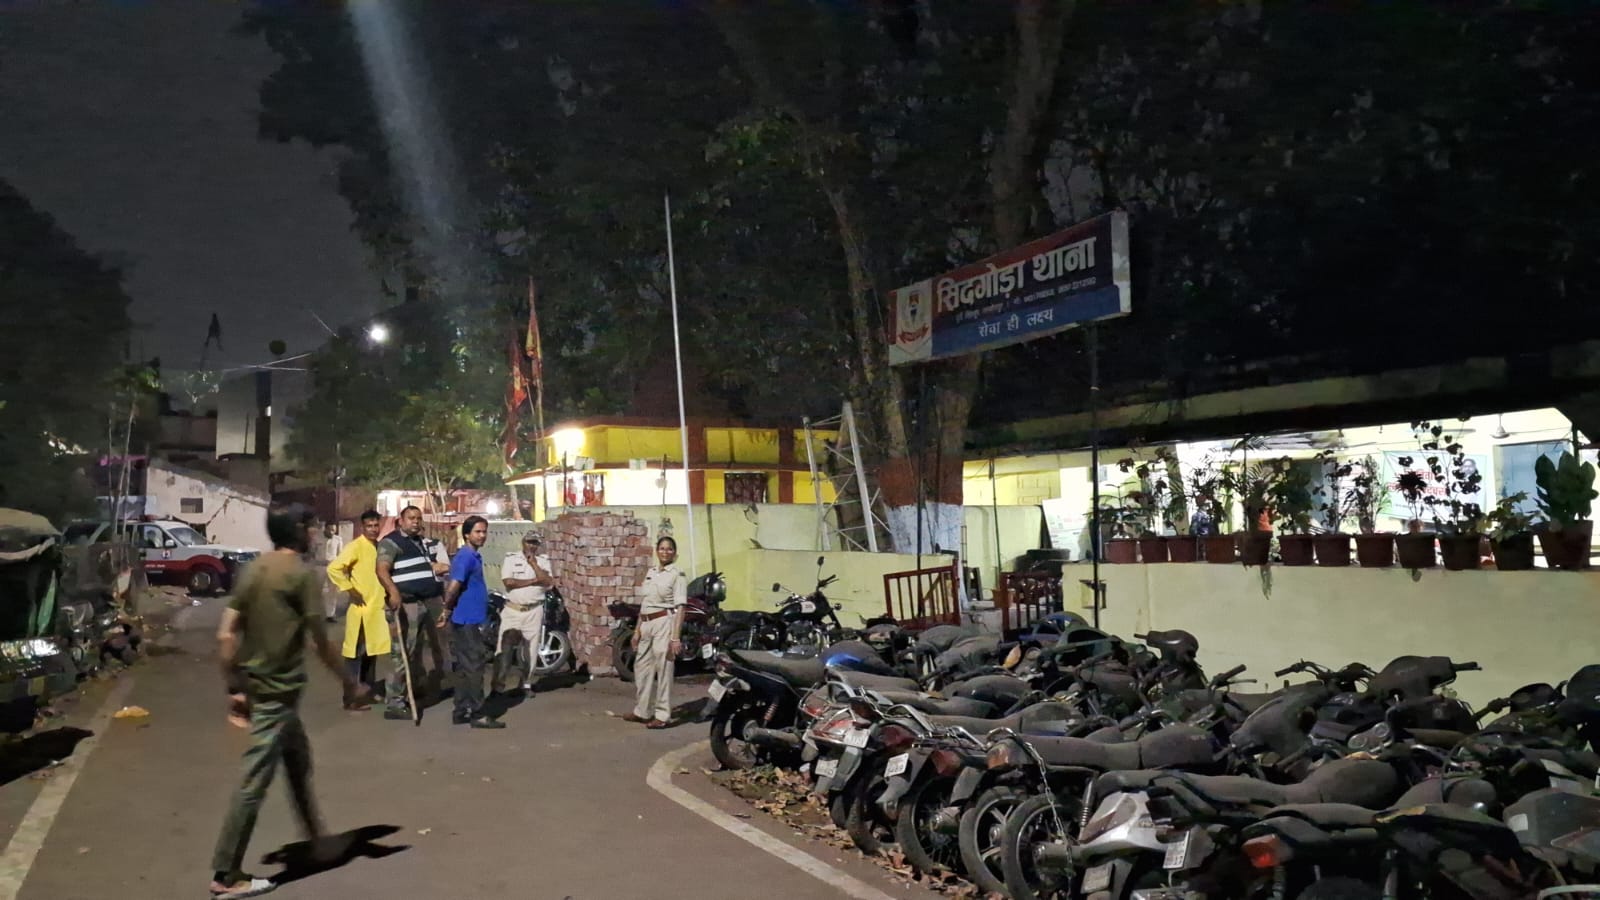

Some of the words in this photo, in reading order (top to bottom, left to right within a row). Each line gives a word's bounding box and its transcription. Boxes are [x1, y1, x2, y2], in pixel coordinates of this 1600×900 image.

[937, 260, 1026, 312] सिदगोड़ा
[1032, 237, 1097, 281] थाना
[977, 321, 1000, 337] सेवा
[1007, 314, 1019, 331] ही
[1027, 308, 1054, 326] लक्ष्य
